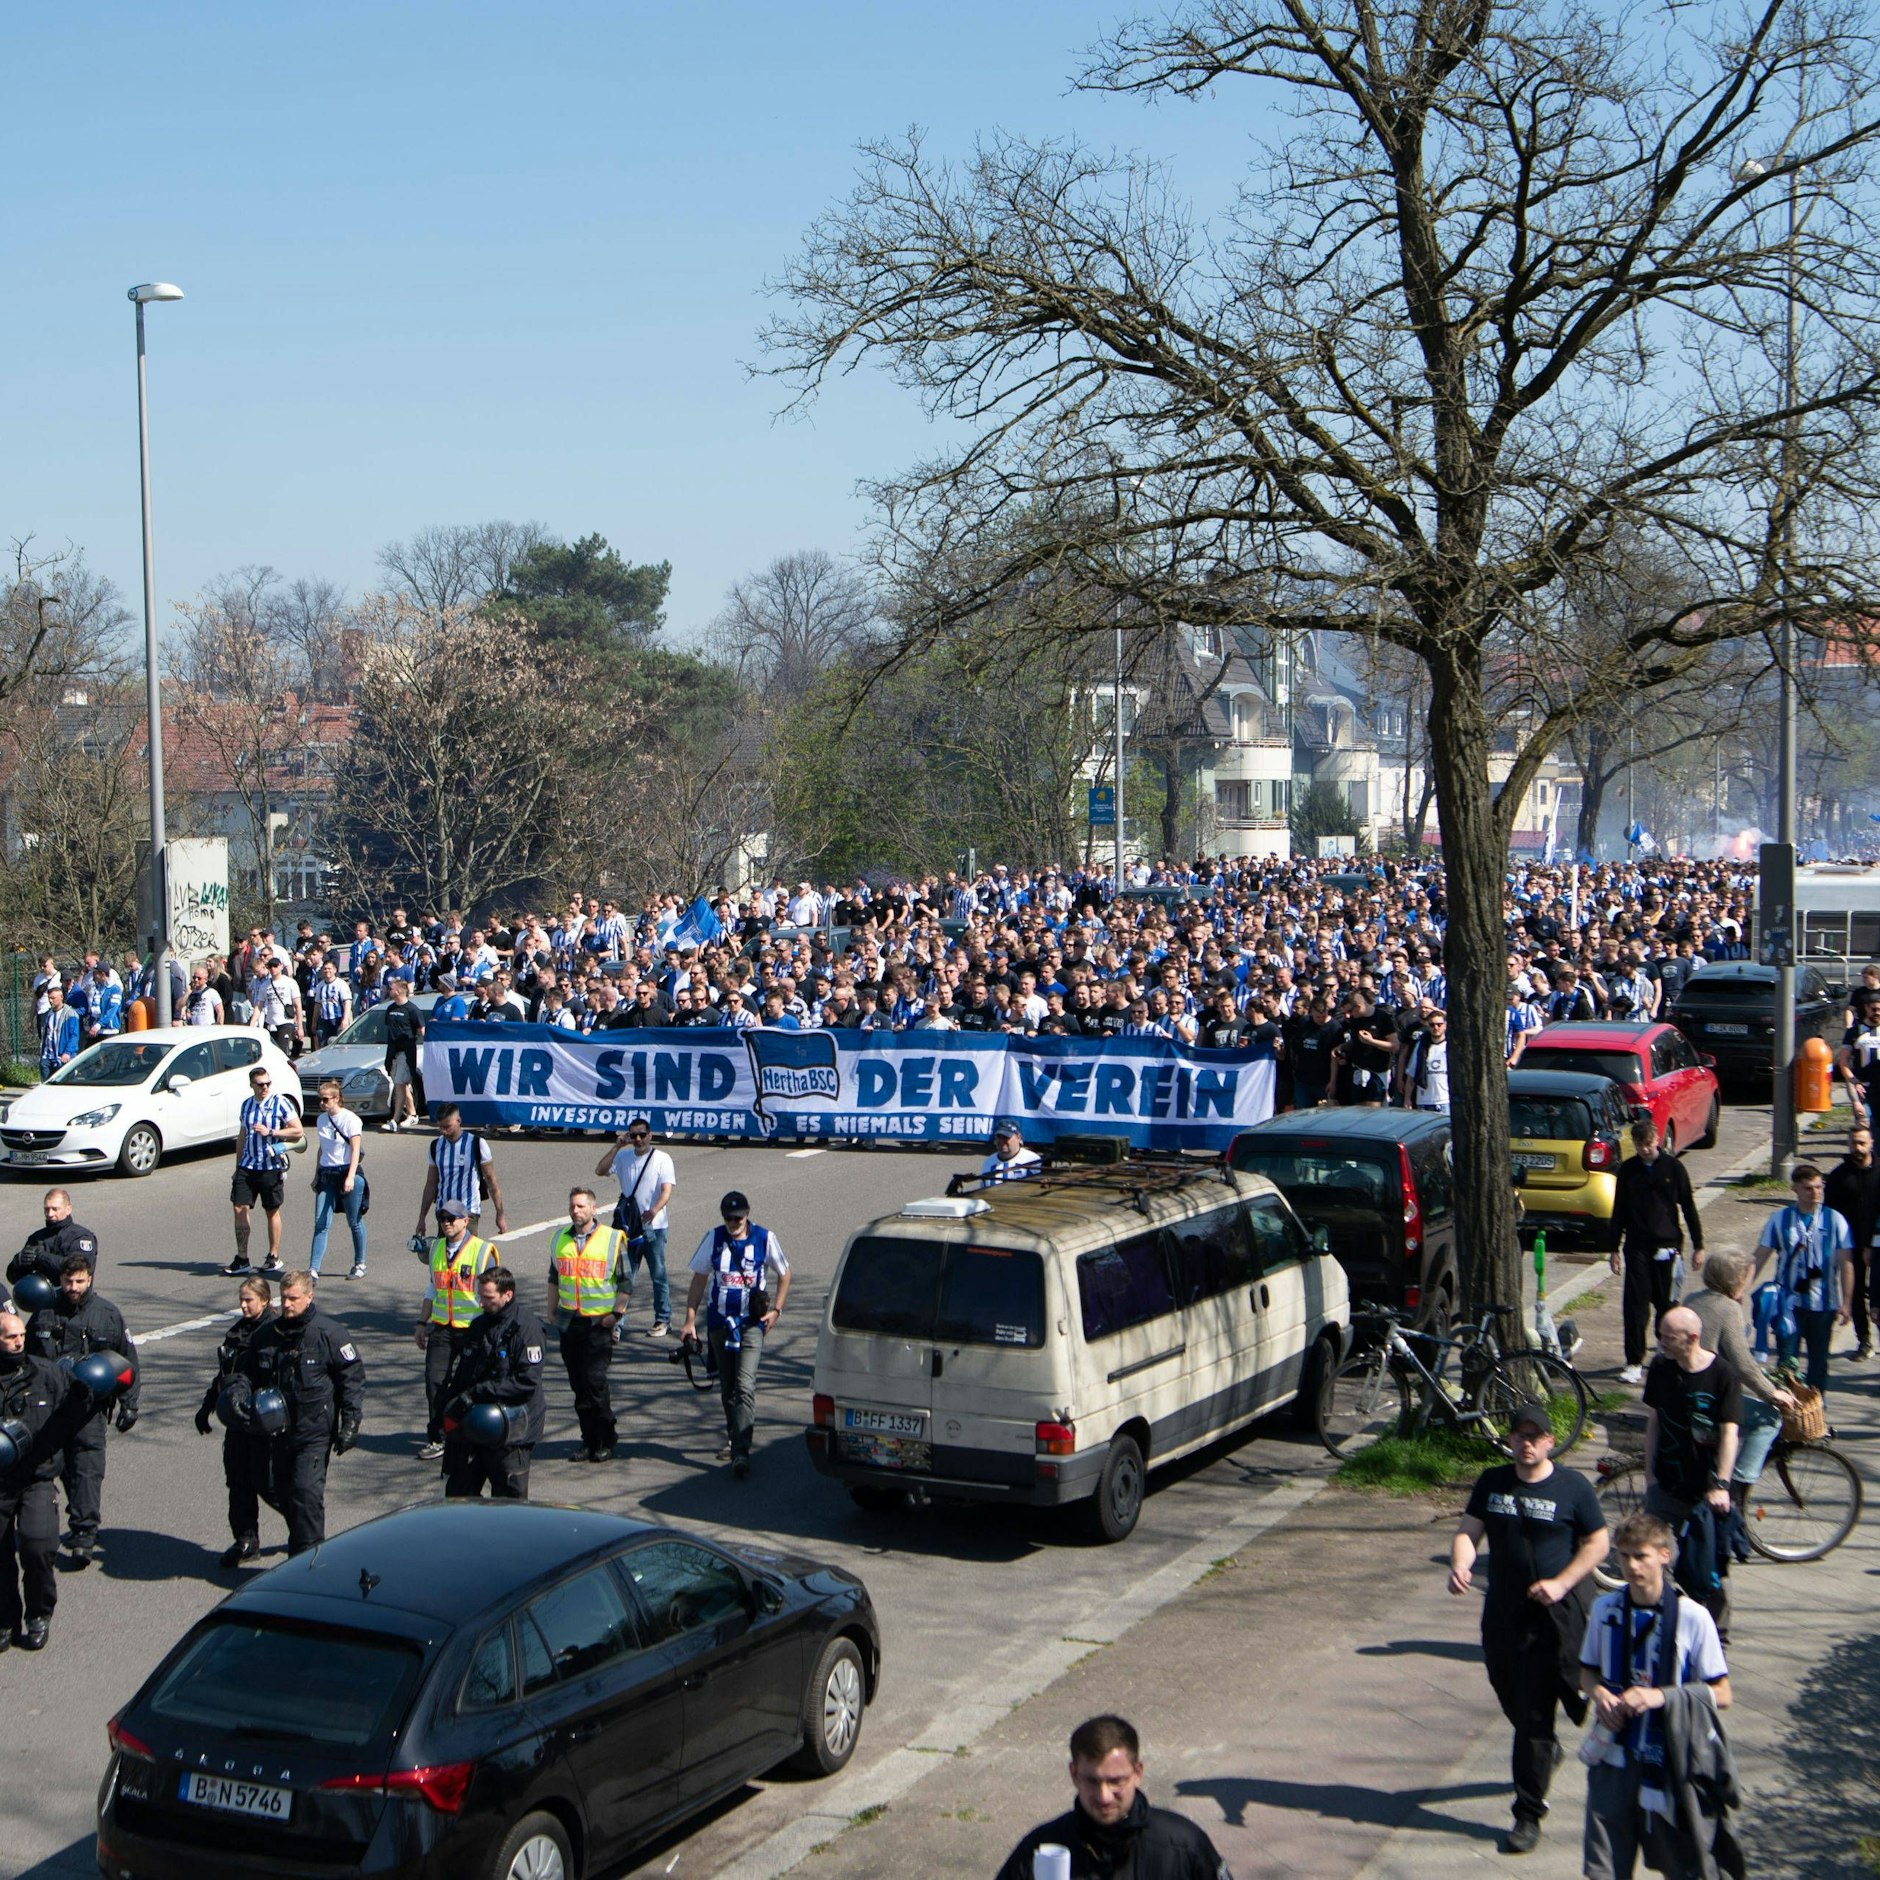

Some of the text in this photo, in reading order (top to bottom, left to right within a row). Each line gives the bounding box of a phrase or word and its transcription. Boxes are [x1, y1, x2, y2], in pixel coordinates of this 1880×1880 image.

[448, 1047, 1239, 1118] WIR SIND DER VEREIN
[664, 1111, 746, 1130] WERDEN
[796, 1115, 821, 1133] ES
[834, 1115, 927, 1134] NIEMALS
[854, 1410, 920, 1432] B FF 1337
[195, 1777, 282, 1814] B N 5746
